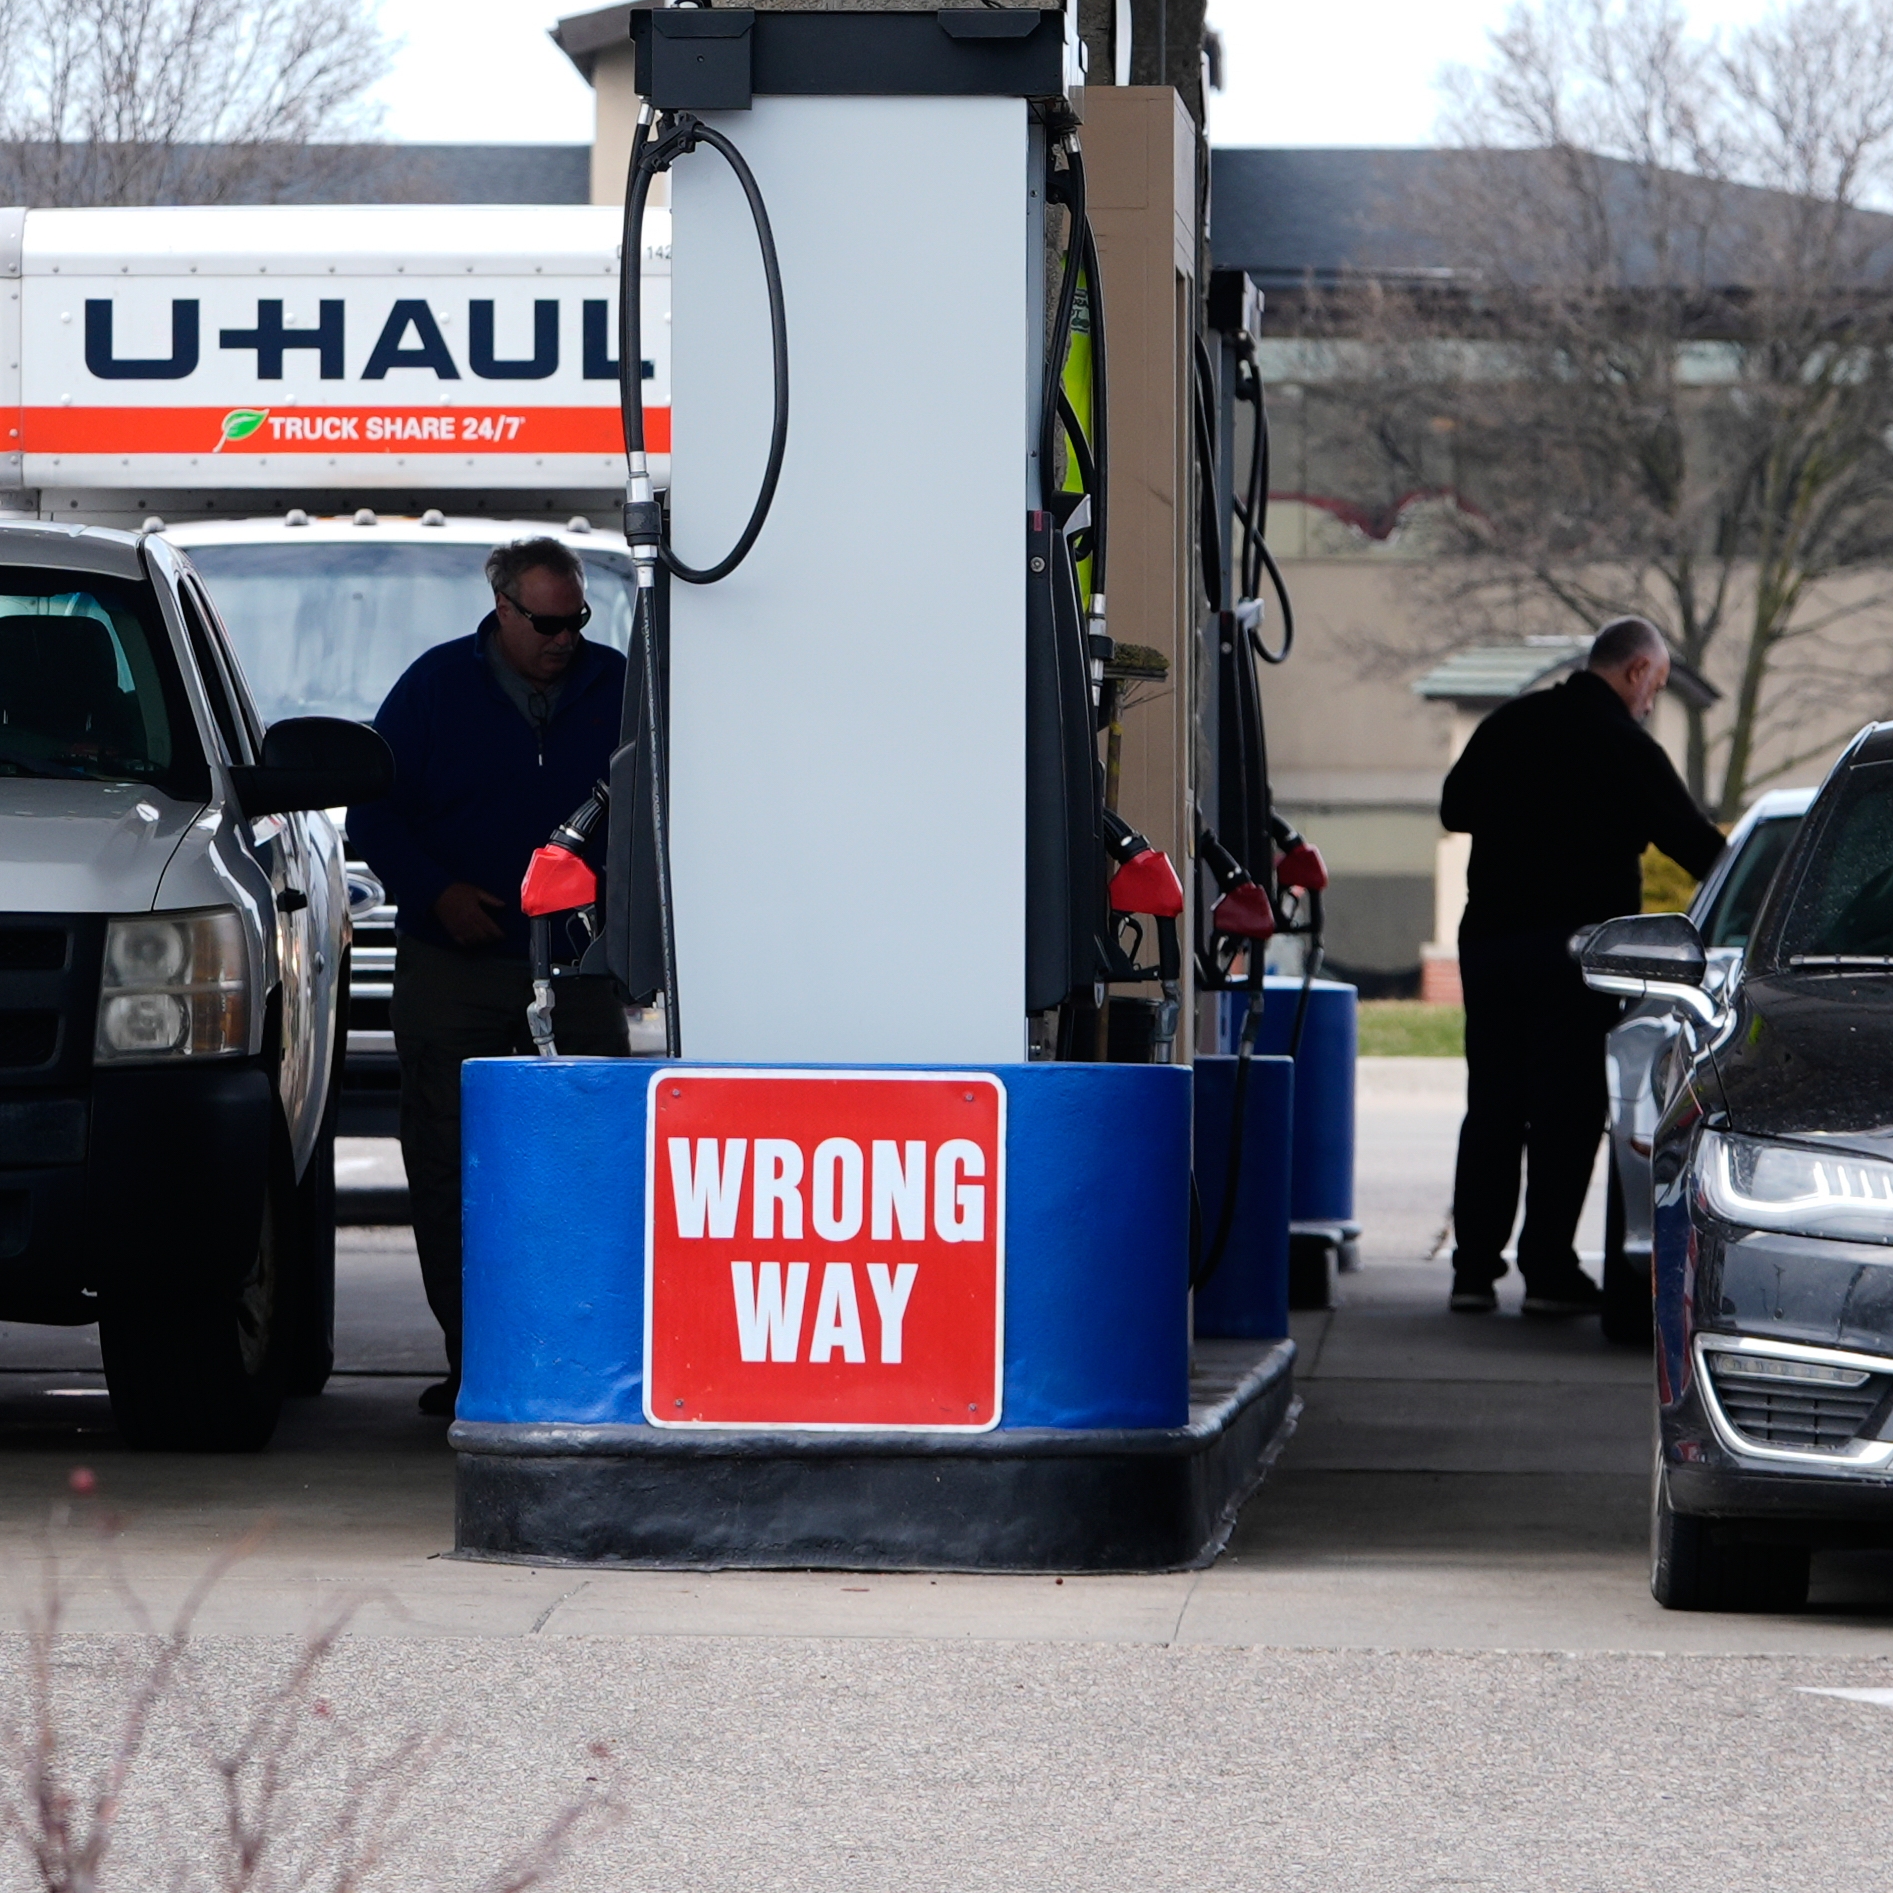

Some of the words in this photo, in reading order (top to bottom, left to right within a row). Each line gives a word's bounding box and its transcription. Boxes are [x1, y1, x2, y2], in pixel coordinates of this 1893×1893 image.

[268, 415, 360, 441] TRUCK
[365, 415, 457, 441] SHARE
[461, 414, 522, 443] 24/7
[667, 1136, 986, 1243] WRONG
[730, 1261, 919, 1364] WAY
